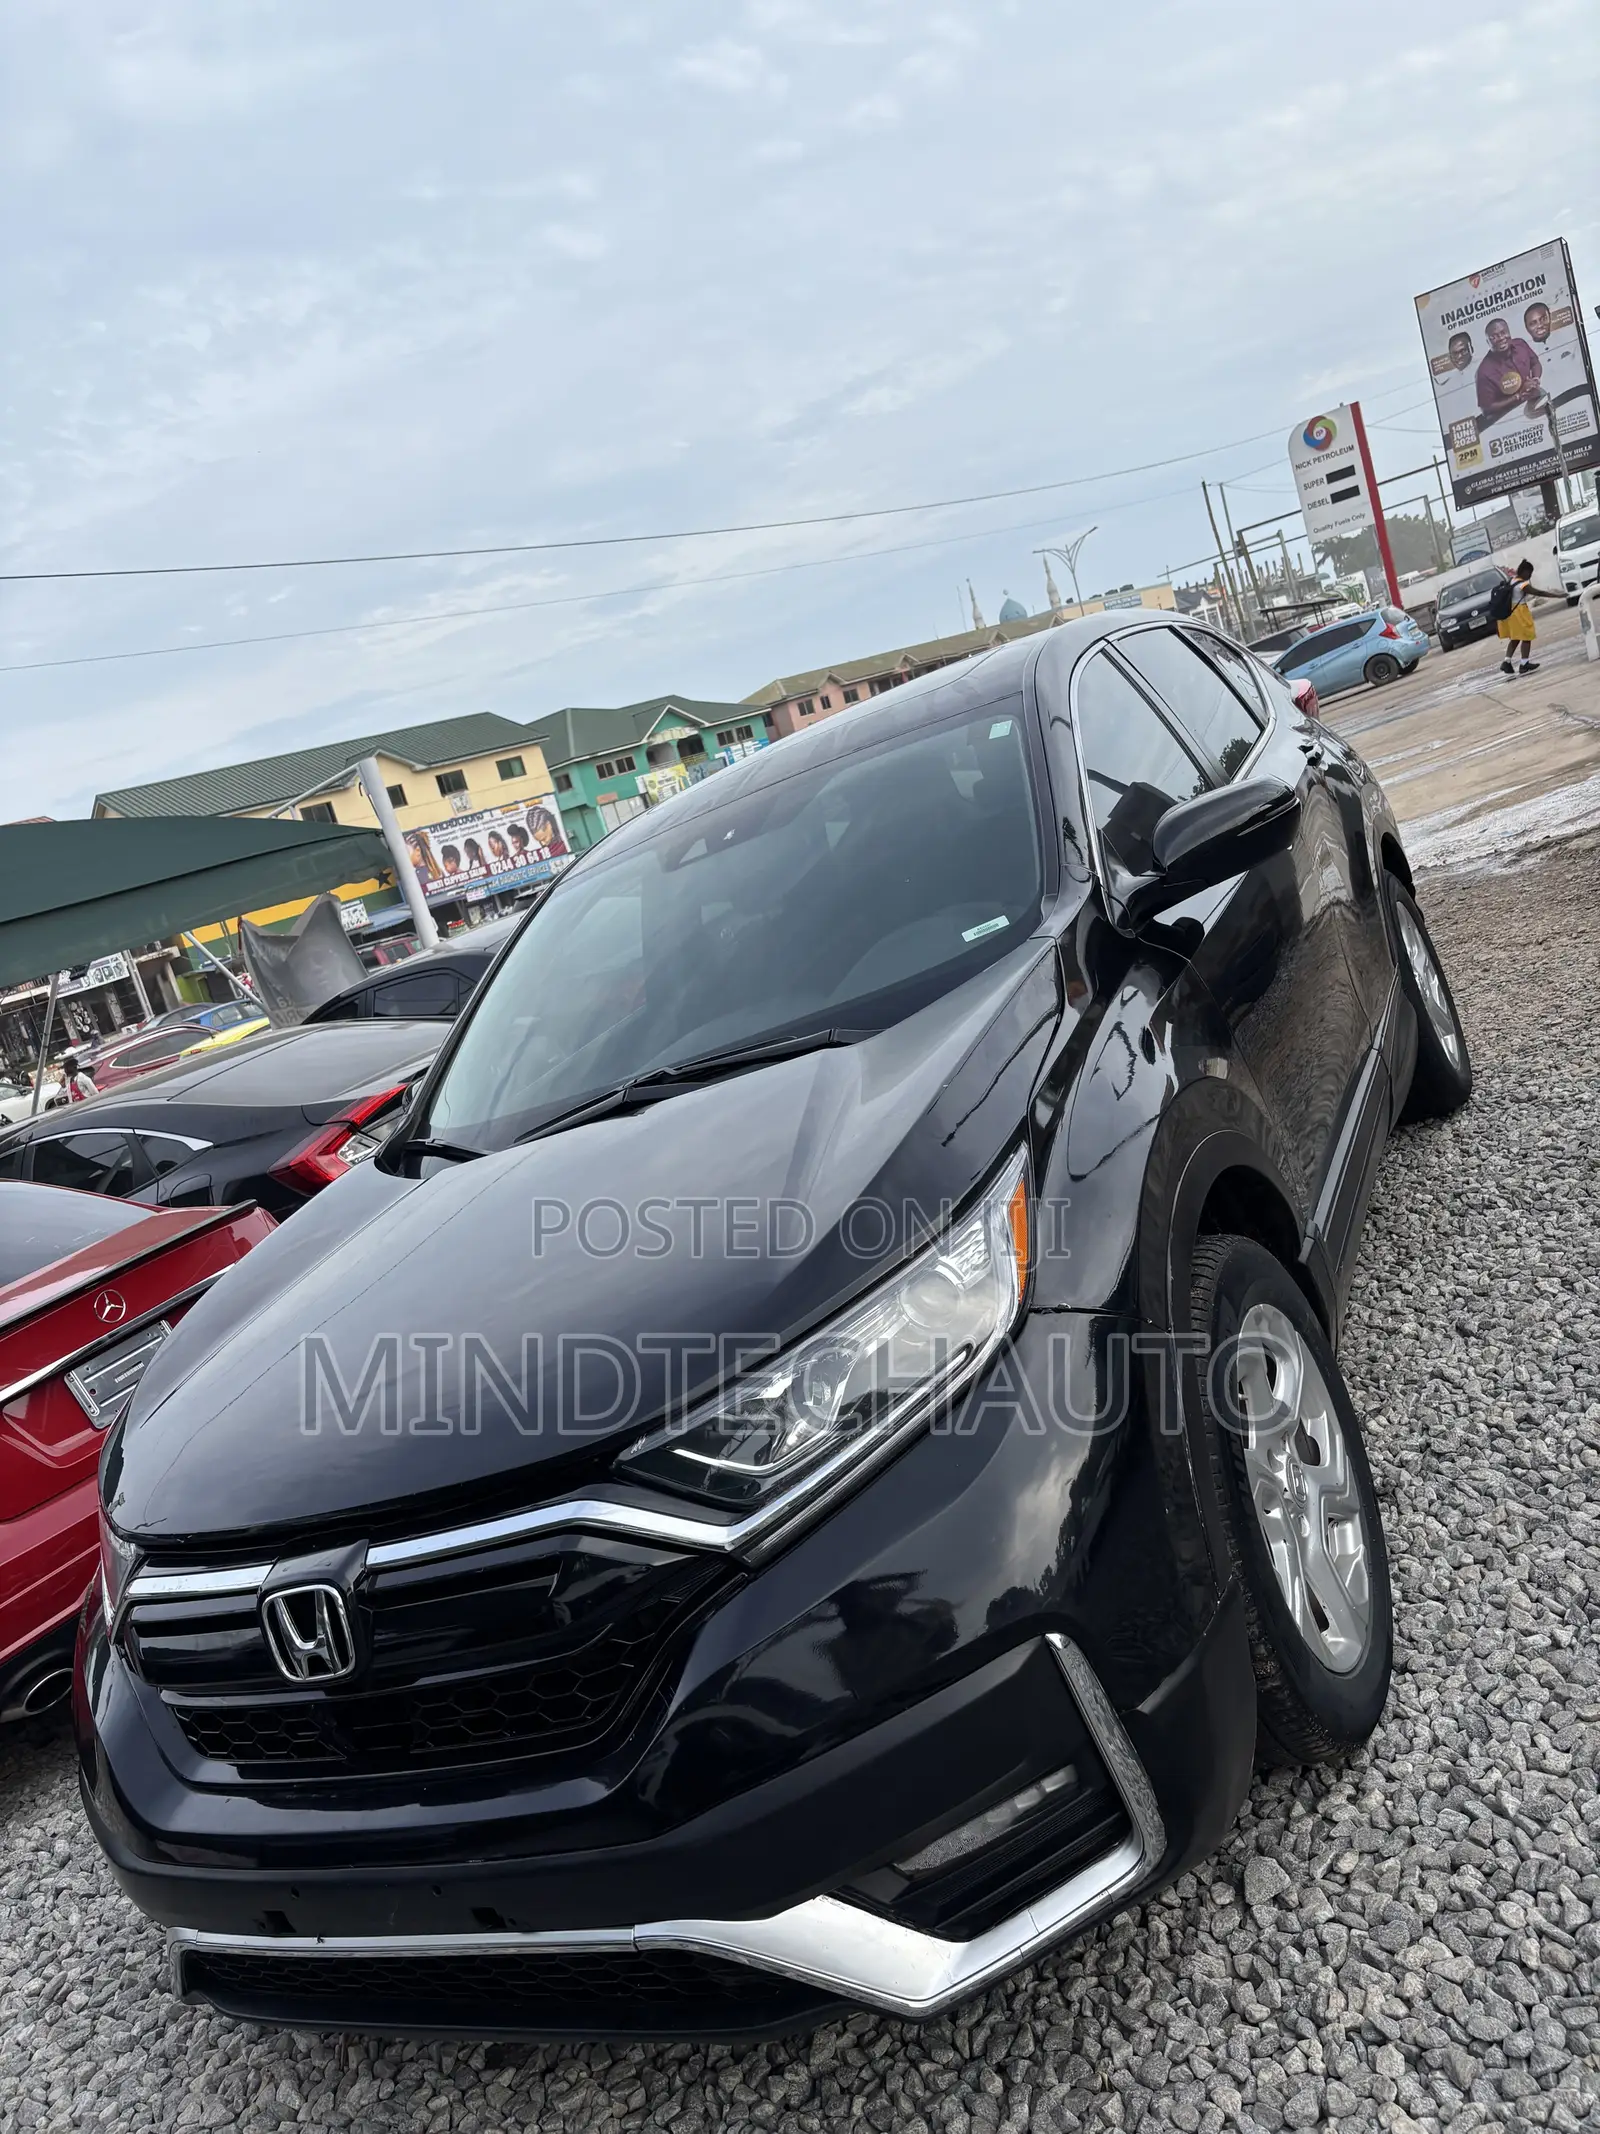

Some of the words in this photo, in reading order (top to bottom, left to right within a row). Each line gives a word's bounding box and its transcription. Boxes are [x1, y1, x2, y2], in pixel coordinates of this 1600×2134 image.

[1440, 273, 1547, 326] INAUGURATION
[1447, 321, 1458, 331] OF
[1458, 315, 1475, 328] NEW
[1475, 304, 1507, 321] CHURCH
[1507, 288, 1544, 308] BUILDING
[1452, 419, 1475, 432] 14TH
[1453, 427, 1476, 440] JUNE
[1454, 434, 1477, 449] 2026
[1503, 437, 1519, 449] ALL
[1519, 430, 1545, 443] NIGHT
[1504, 437, 1545, 455] SERVICES
[1458, 448, 1479, 463] 2PM
[1490, 440, 1502, 457] 3
[1295, 458, 1312, 471] NICK
[1312, 444, 1356, 466] PETROLEUM
[1303, 477, 1326, 491] SUPER
[1307, 498, 1331, 511] DIESEL
[1313, 522, 1334, 535] Quality
[1334, 517, 1351, 528] Fuels
[1351, 512, 1367, 524] Only
[489, 859, 514, 876] 0244
[513, 854, 527, 868] 30
[527, 851, 540, 864] 64
[540, 846, 552, 859] 18
